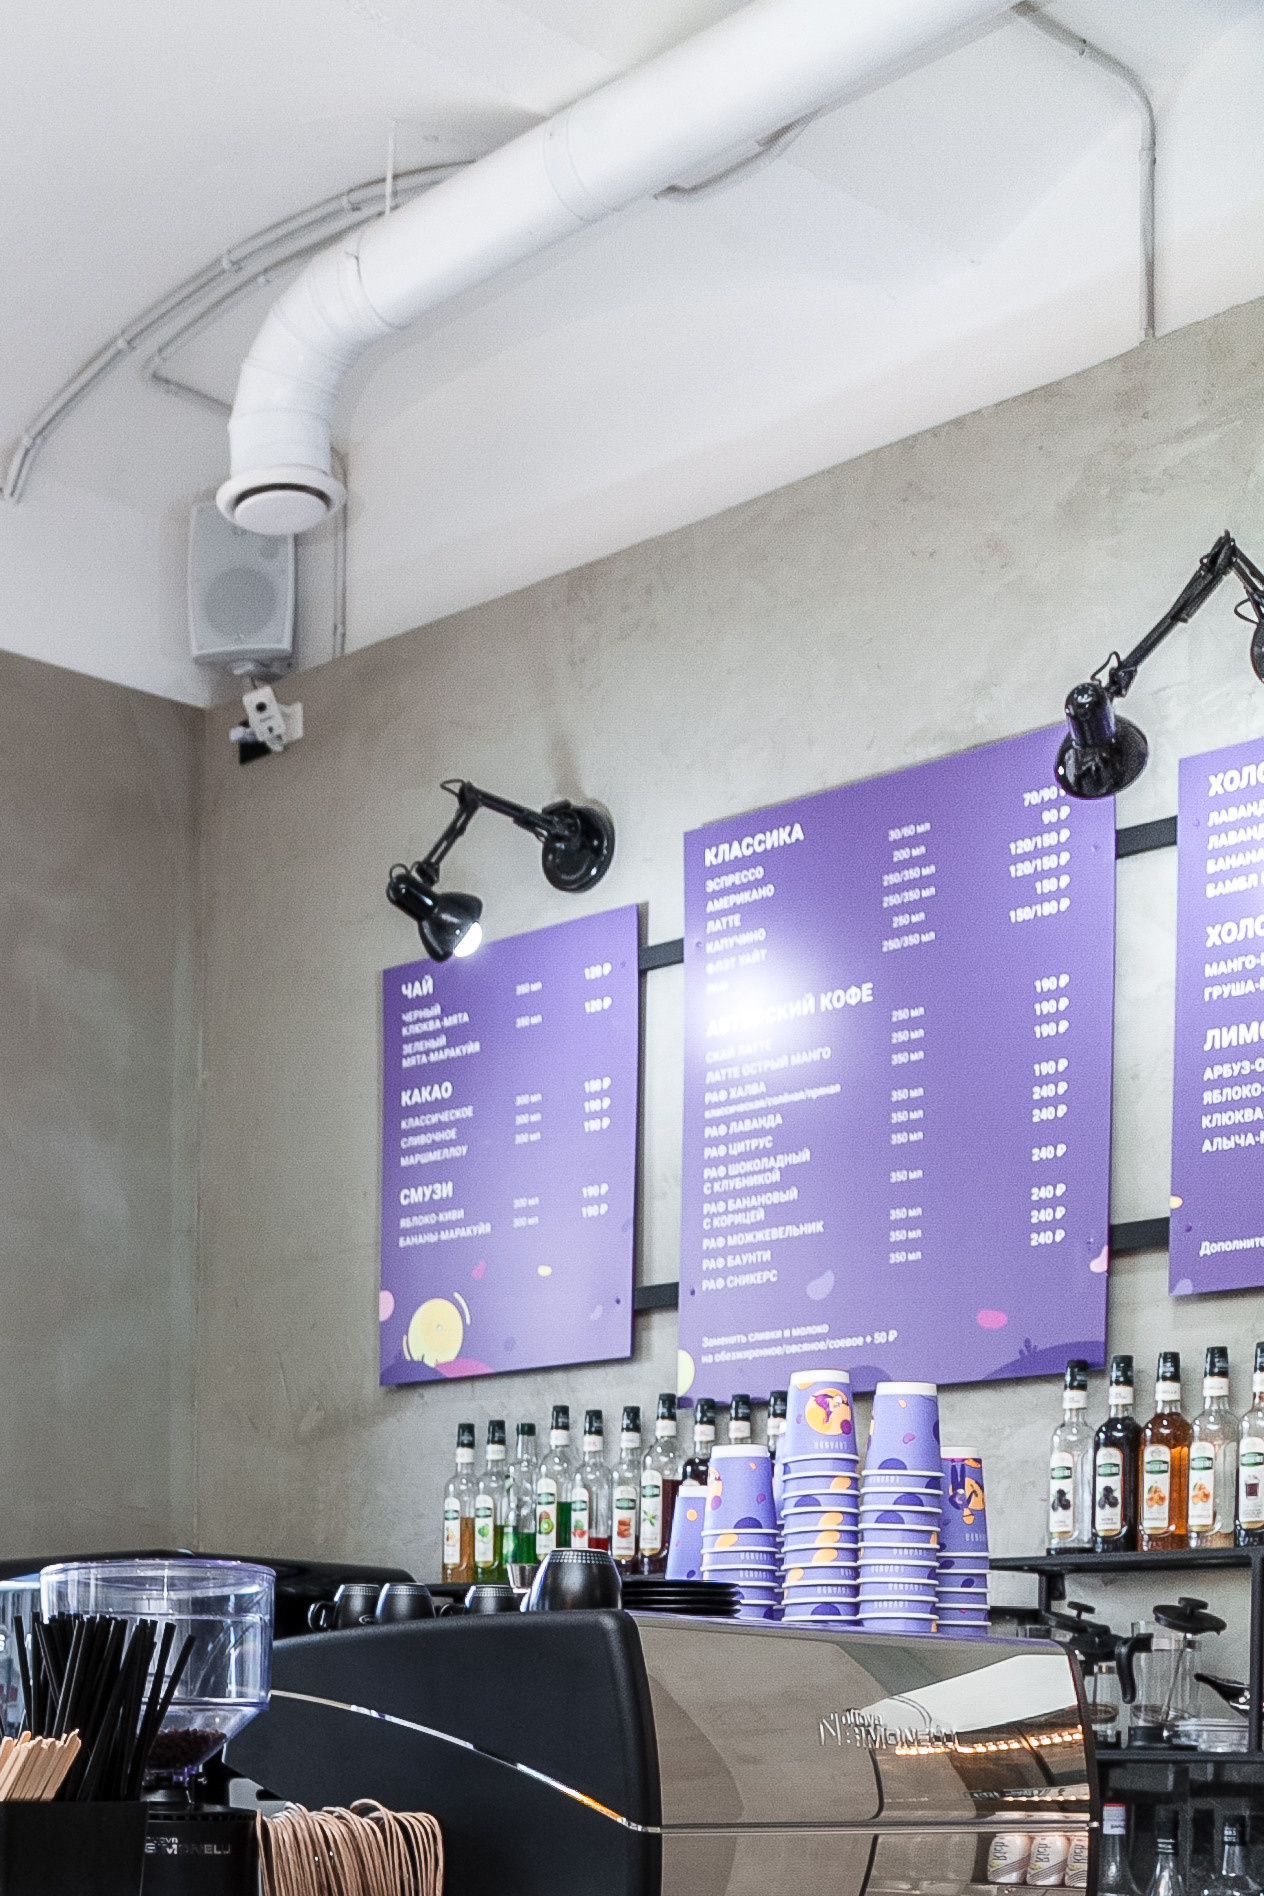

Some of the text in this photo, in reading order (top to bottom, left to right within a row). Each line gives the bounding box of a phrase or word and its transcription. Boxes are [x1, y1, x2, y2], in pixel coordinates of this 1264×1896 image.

[705, 823, 804, 867] КЛАССИКА
[706, 866, 764, 892] ЭСПРЕССО
[706, 884, 774, 913] АМЕРИКАНО
[706, 914, 741, 935] ЛАТТЕ
[706, 928, 766, 956] КАПУЧИНО
[402, 975, 433, 998] ЧАЙ
[818, 983, 873, 1016] КОФЕ
[1203, 1019, 1264, 1052] ЛИМ
[706, 1061, 743, 1084] ЛАТТЕ
[788, 1046, 831, 1068] МАНГО
[401, 1082, 452, 1106] КАКАО
[705, 1081, 766, 1104] РАФ ХАЛВА
[910, 1087, 923, 1098] мл
[1033, 1083, 1059, 1099] 240
[401, 1105, 475, 1129] КЛАССИЧЕСКОЕ
[907, 1110, 923, 1120] мл
[1032, 1105, 1059, 1122] 240
[704, 1113, 782, 1138] РАФ ЛАВАНДА
[907, 1131, 923, 1141] мл
[401, 1128, 457, 1148] СЛИВОЧНОЕ
[704, 1136, 773, 1159] РАФ ЦИТРУС
[401, 1144, 468, 1166] МАРШМЕЛЛОУ
[1032, 1145, 1058, 1161] 240
[703, 1148, 810, 1180] РАФ ШОКОЛАДНЫЙ
[909, 1170, 923, 1179] мл
[713, 1166, 783, 1193] КЛУБНИКОЙ
[400, 1181, 453, 1205] СМУЗИ
[703, 1187, 798, 1215] РАФ БАНАНОВЫЙ
[1031, 1185, 1057, 1200] 240
[713, 1207, 764, 1228] КОРИЦЕЙ
[906, 1207, 922, 1217] мл
[1031, 1208, 1057, 1223] 240
[703, 1221, 823, 1250] РАФ МОЖЖЕВЕЛЬНИК
[908, 1229, 922, 1239] мл
[1031, 1230, 1057, 1246] 240
[702, 1250, 771, 1271] РАФ БАУНТИ
[908, 1251, 921, 1261] мл
[702, 1270, 777, 1291] РАФ СНИКЕРС
[874, 1331, 890, 1344] 50
